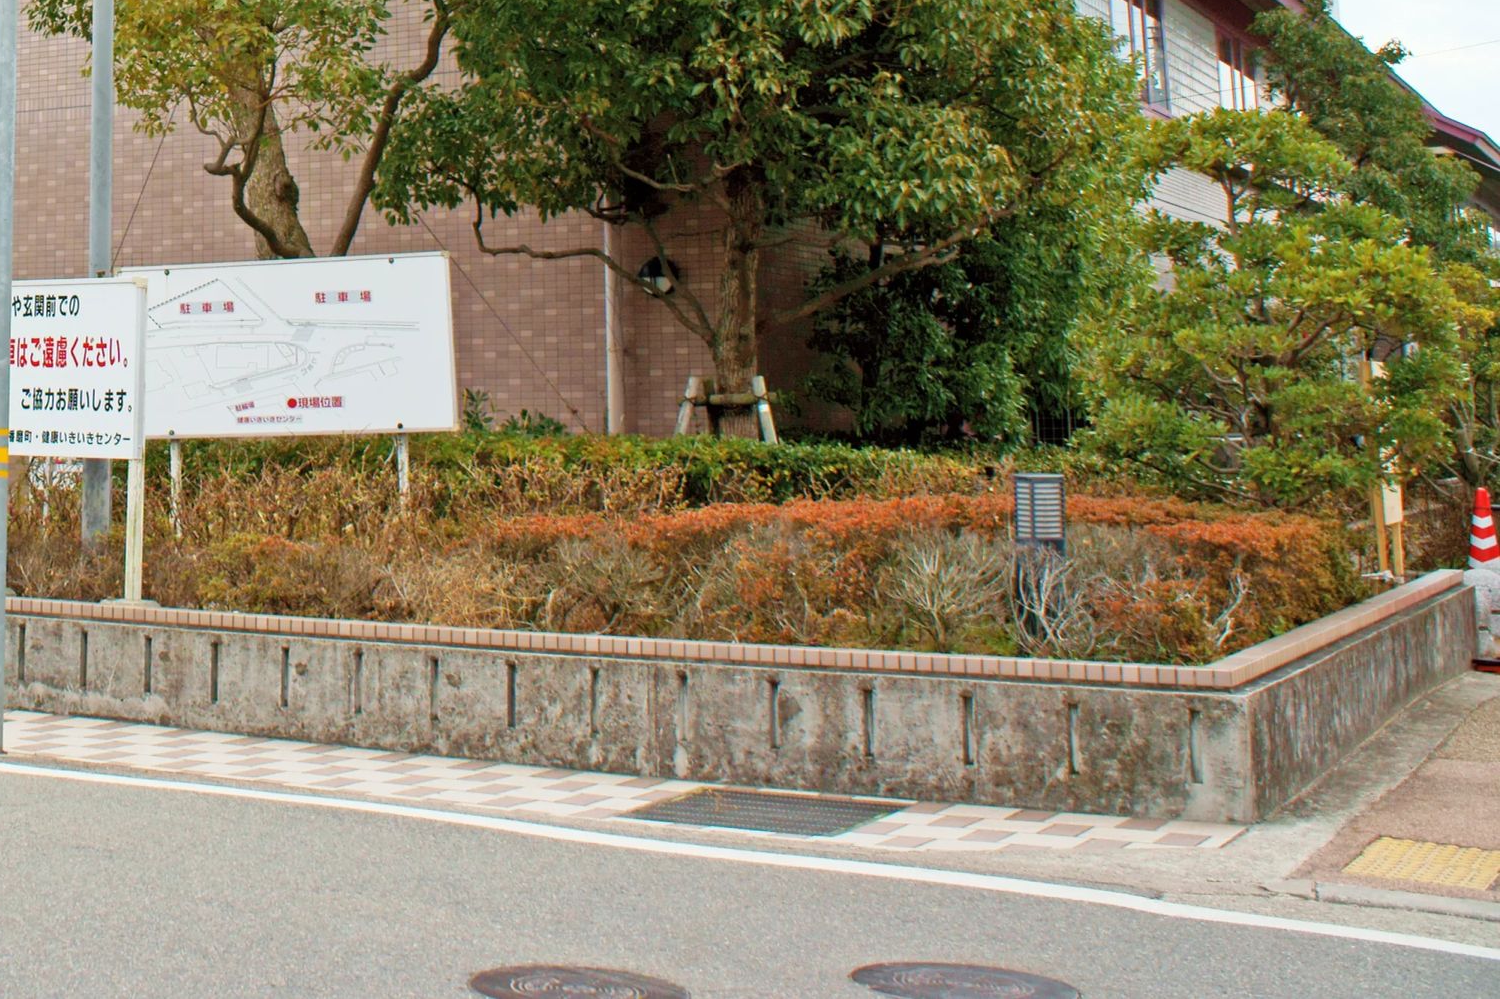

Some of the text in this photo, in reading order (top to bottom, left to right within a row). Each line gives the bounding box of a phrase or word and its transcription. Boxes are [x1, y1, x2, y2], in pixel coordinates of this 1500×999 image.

[315, 290, 371, 303] 駐車場
[12, 294, 80, 317] や玄関前での
[180, 301, 234, 314] 駐車場
[21, 388, 132, 412] ご協力お願いします。
[298, 396, 342, 408] 現場位置
